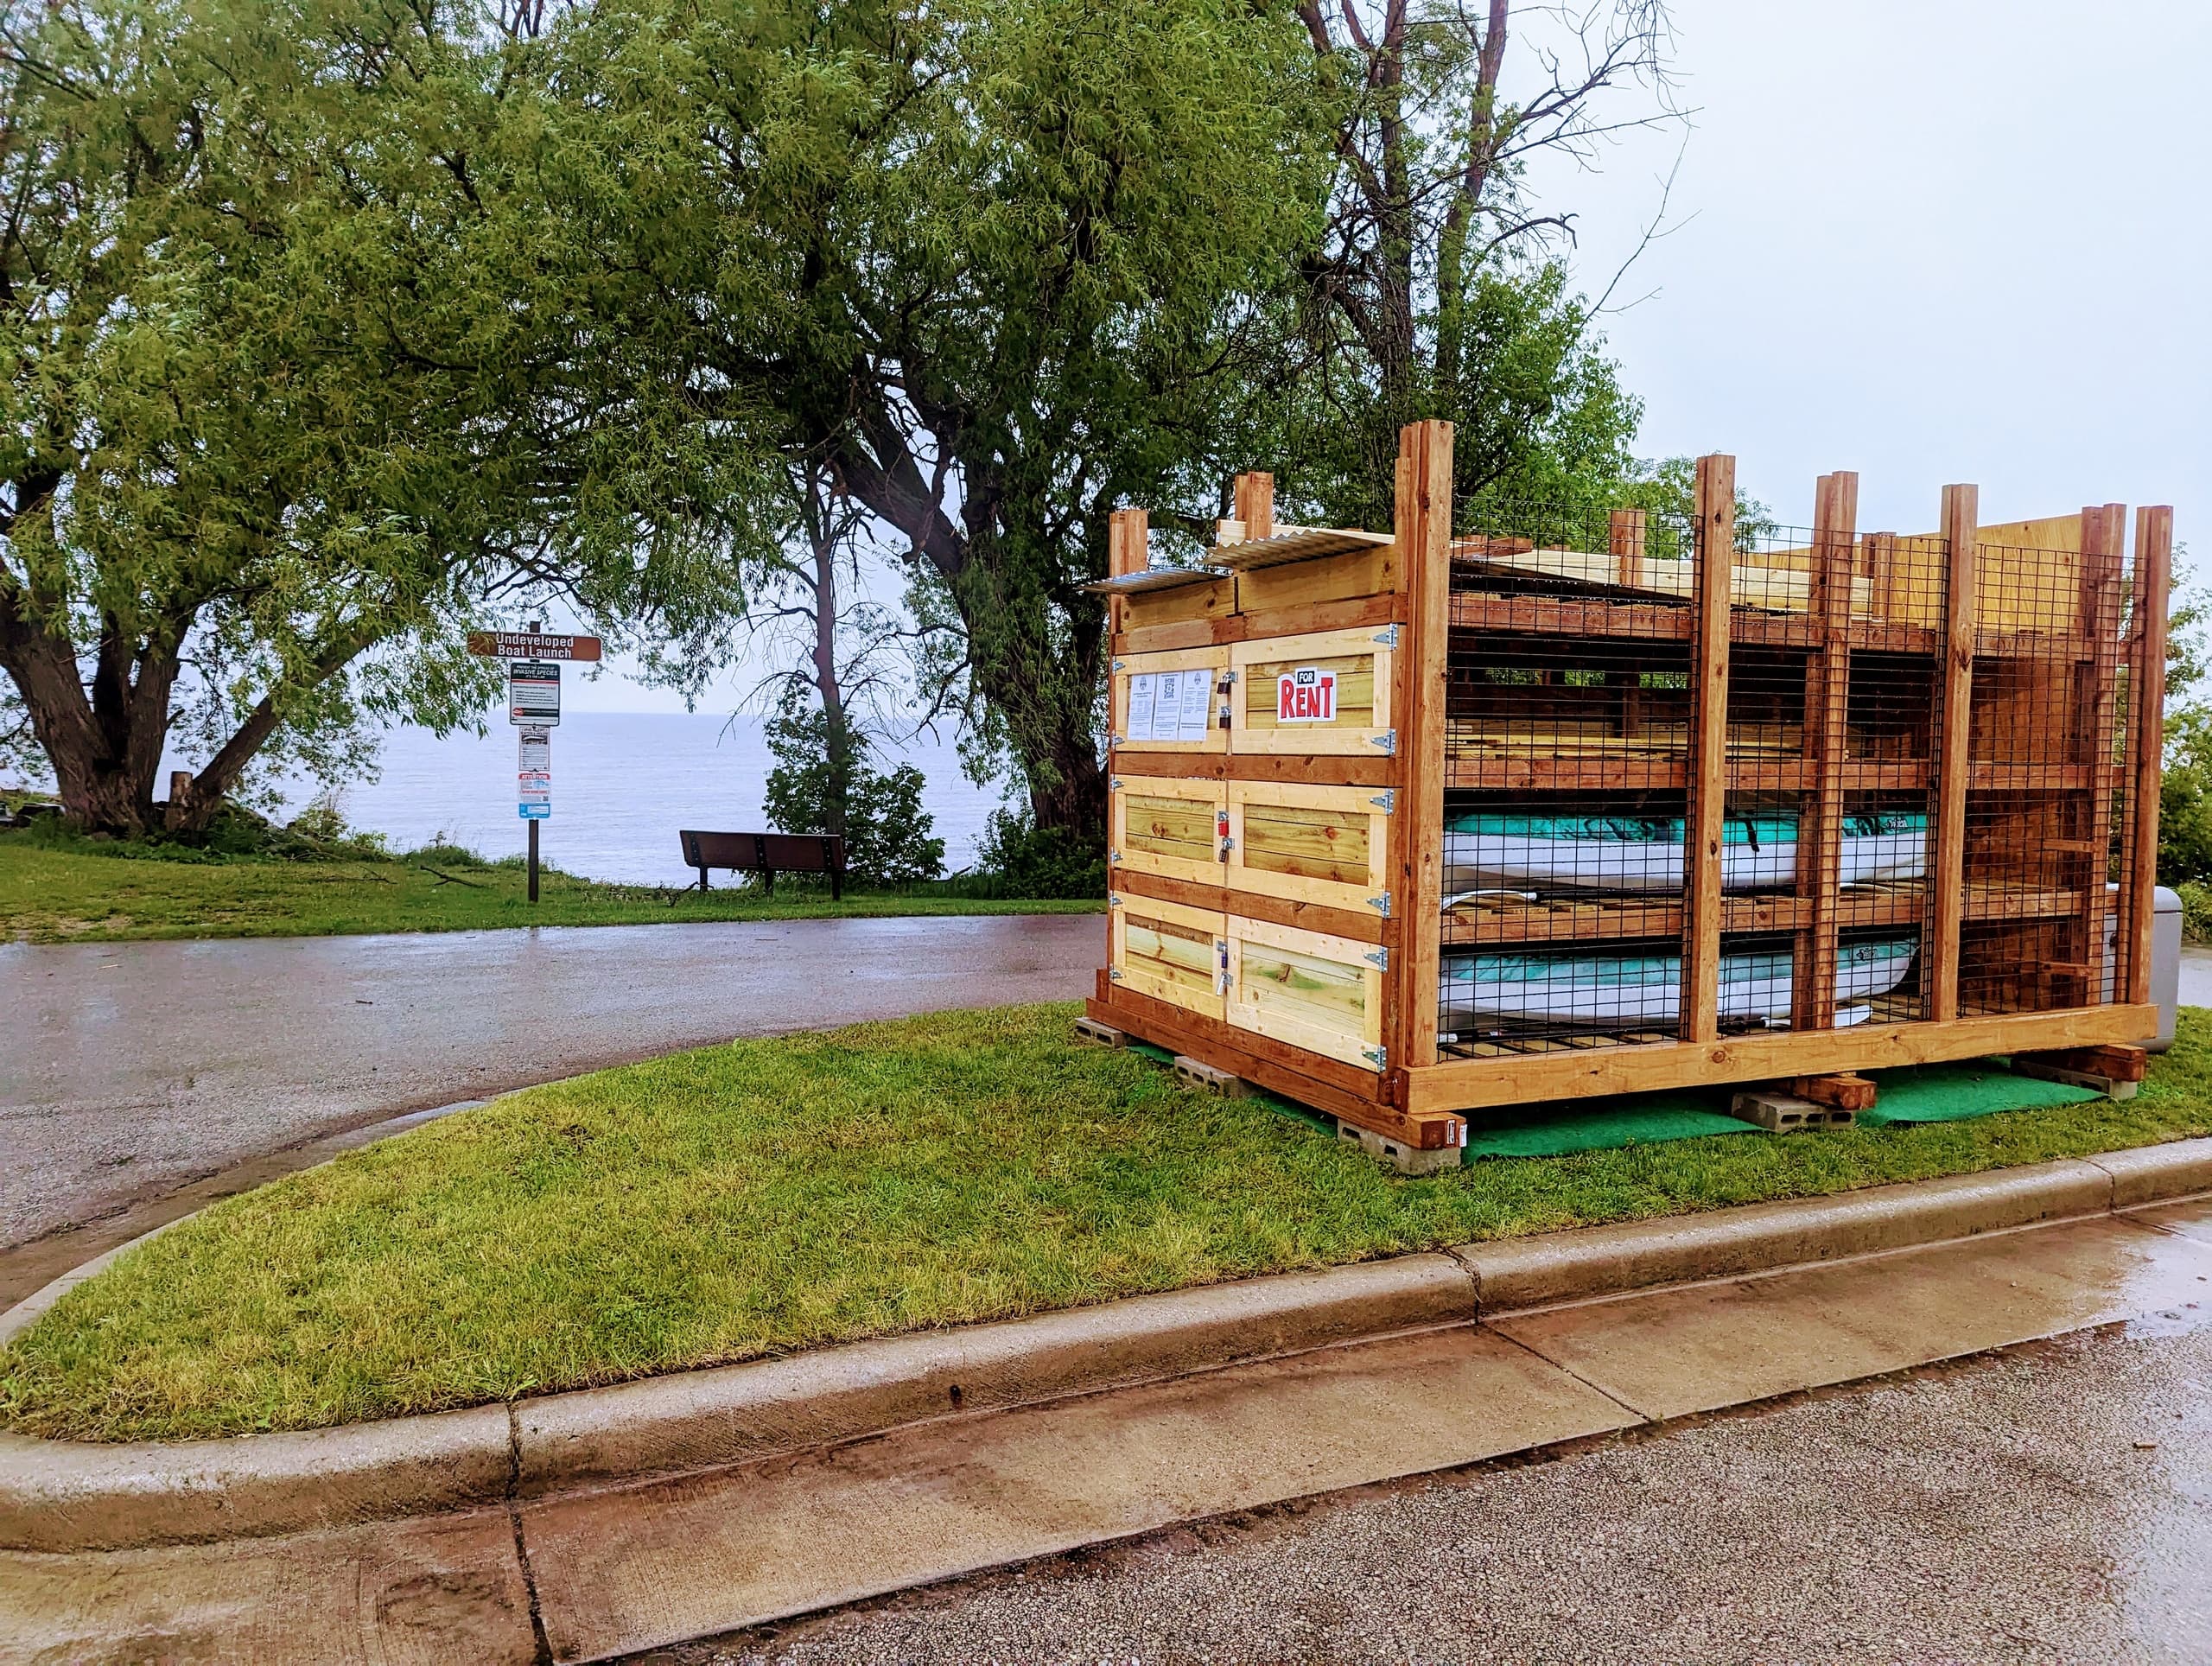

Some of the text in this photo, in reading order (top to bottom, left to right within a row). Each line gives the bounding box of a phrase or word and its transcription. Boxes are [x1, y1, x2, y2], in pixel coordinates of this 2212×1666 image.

[496, 633, 574, 648] Undeveloped
[498, 645, 571, 658] Boat Launch
[1299, 672, 1313, 683] FOR
[1281, 677, 1333, 719] RENT
